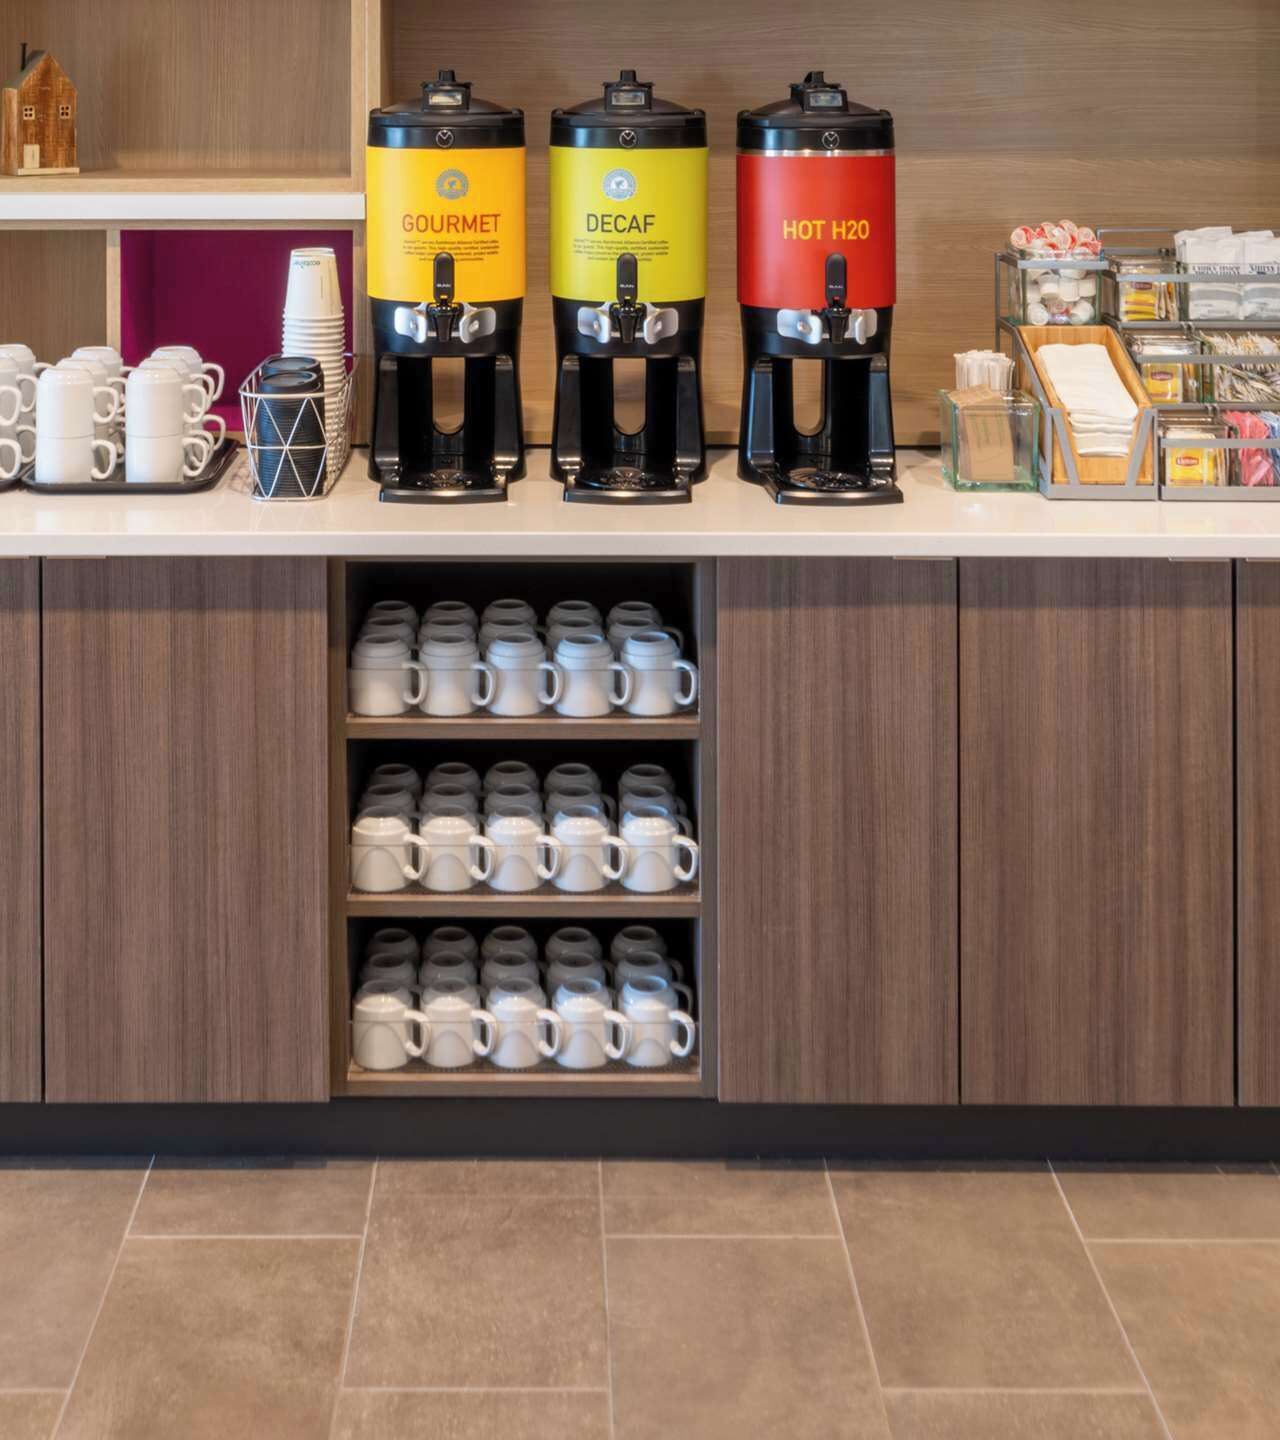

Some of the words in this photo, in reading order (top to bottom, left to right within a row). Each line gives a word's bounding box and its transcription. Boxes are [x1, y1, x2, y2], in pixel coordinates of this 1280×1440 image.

[402, 213, 501, 233] GOURMET
[586, 213, 656, 233] DECAF
[783, 219, 826, 240] HOT
